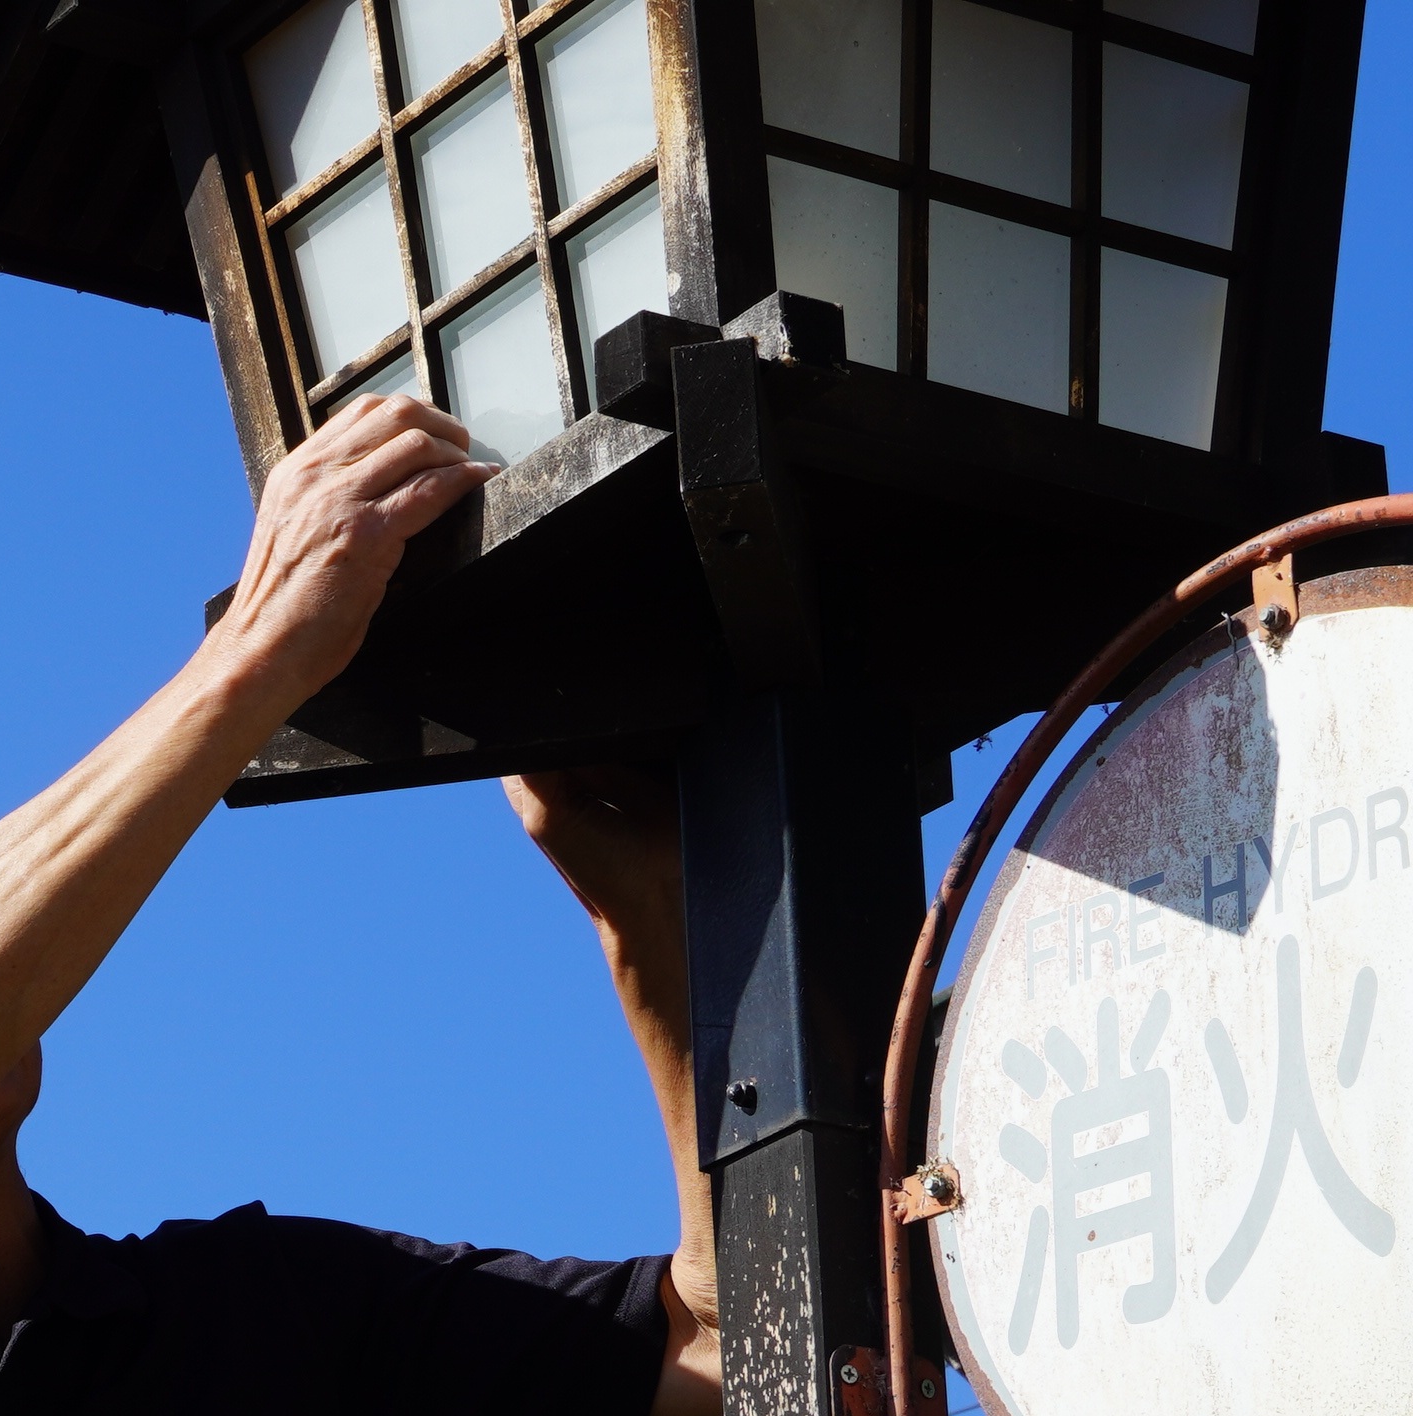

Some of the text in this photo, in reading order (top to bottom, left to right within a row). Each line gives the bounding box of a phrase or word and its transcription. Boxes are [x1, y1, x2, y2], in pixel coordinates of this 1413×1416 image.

[1025, 786, 1411, 1000] FIRE HYDR
[999, 934, 1396, 1355] 消火
